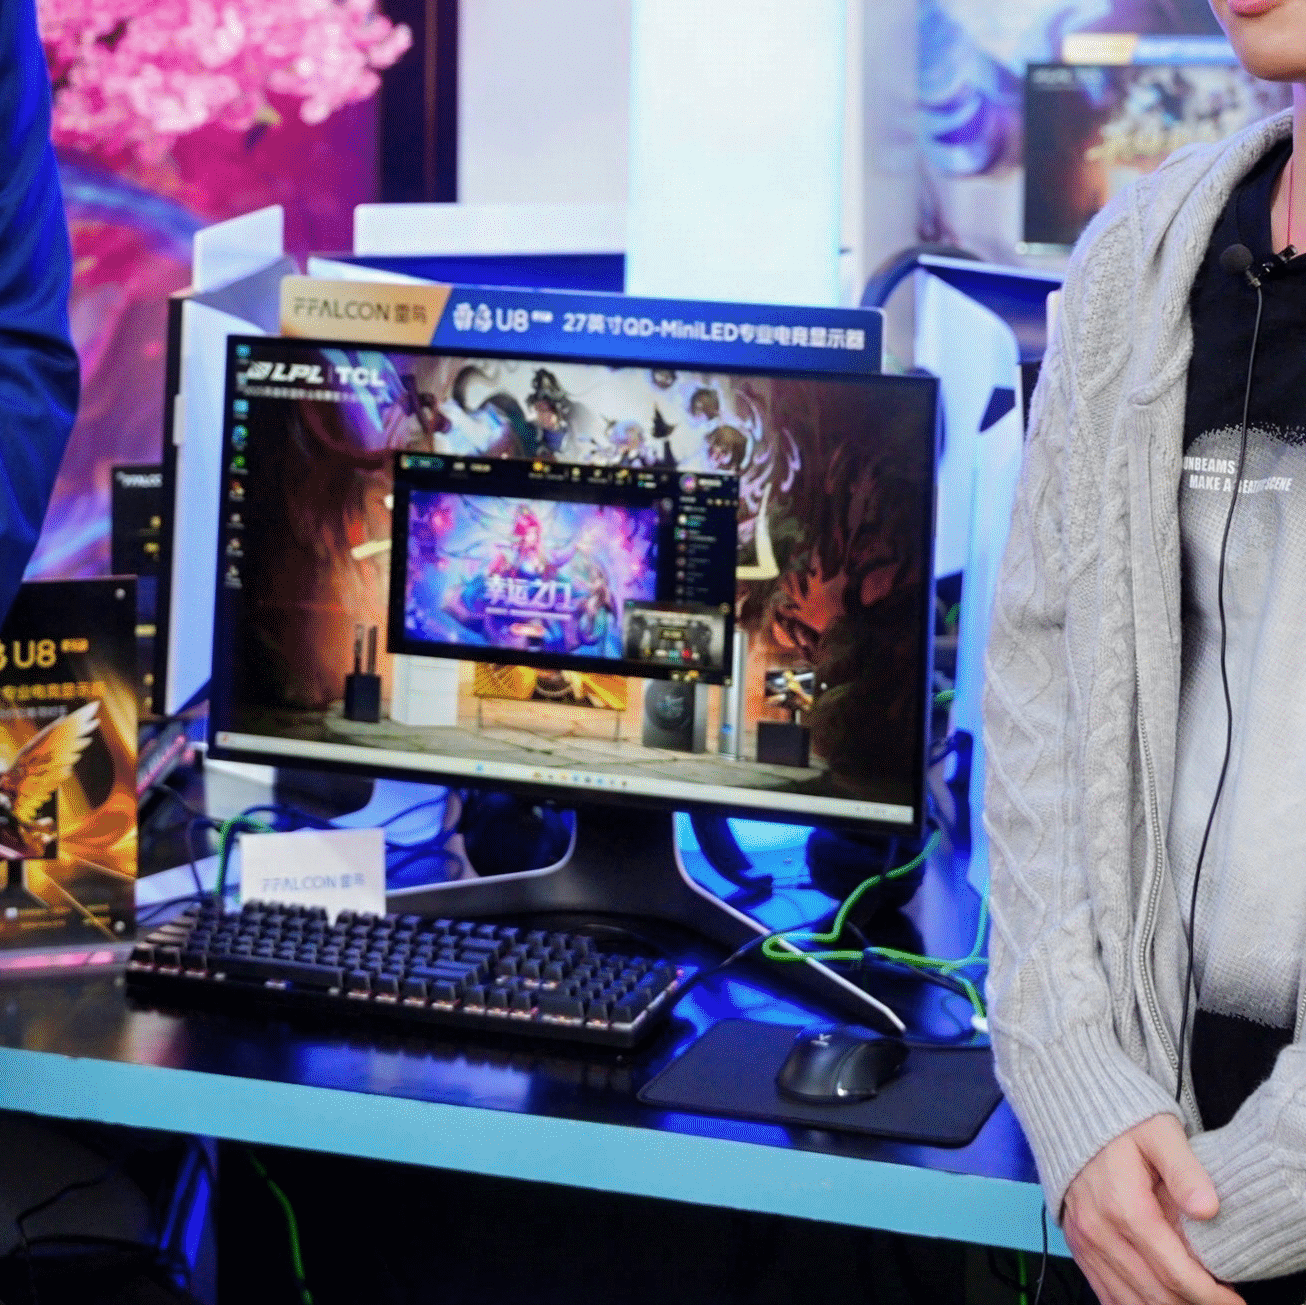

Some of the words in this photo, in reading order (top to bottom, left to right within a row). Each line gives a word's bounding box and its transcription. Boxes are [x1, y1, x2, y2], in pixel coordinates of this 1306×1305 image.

[294, 297, 390, 321] FFALCON
[335, 366, 386, 387] TCL
[1183, 456, 1235, 475] UNBEAMS
[1189, 475, 1221, 491] MAKE
[1223, 477, 1232, 493] A
